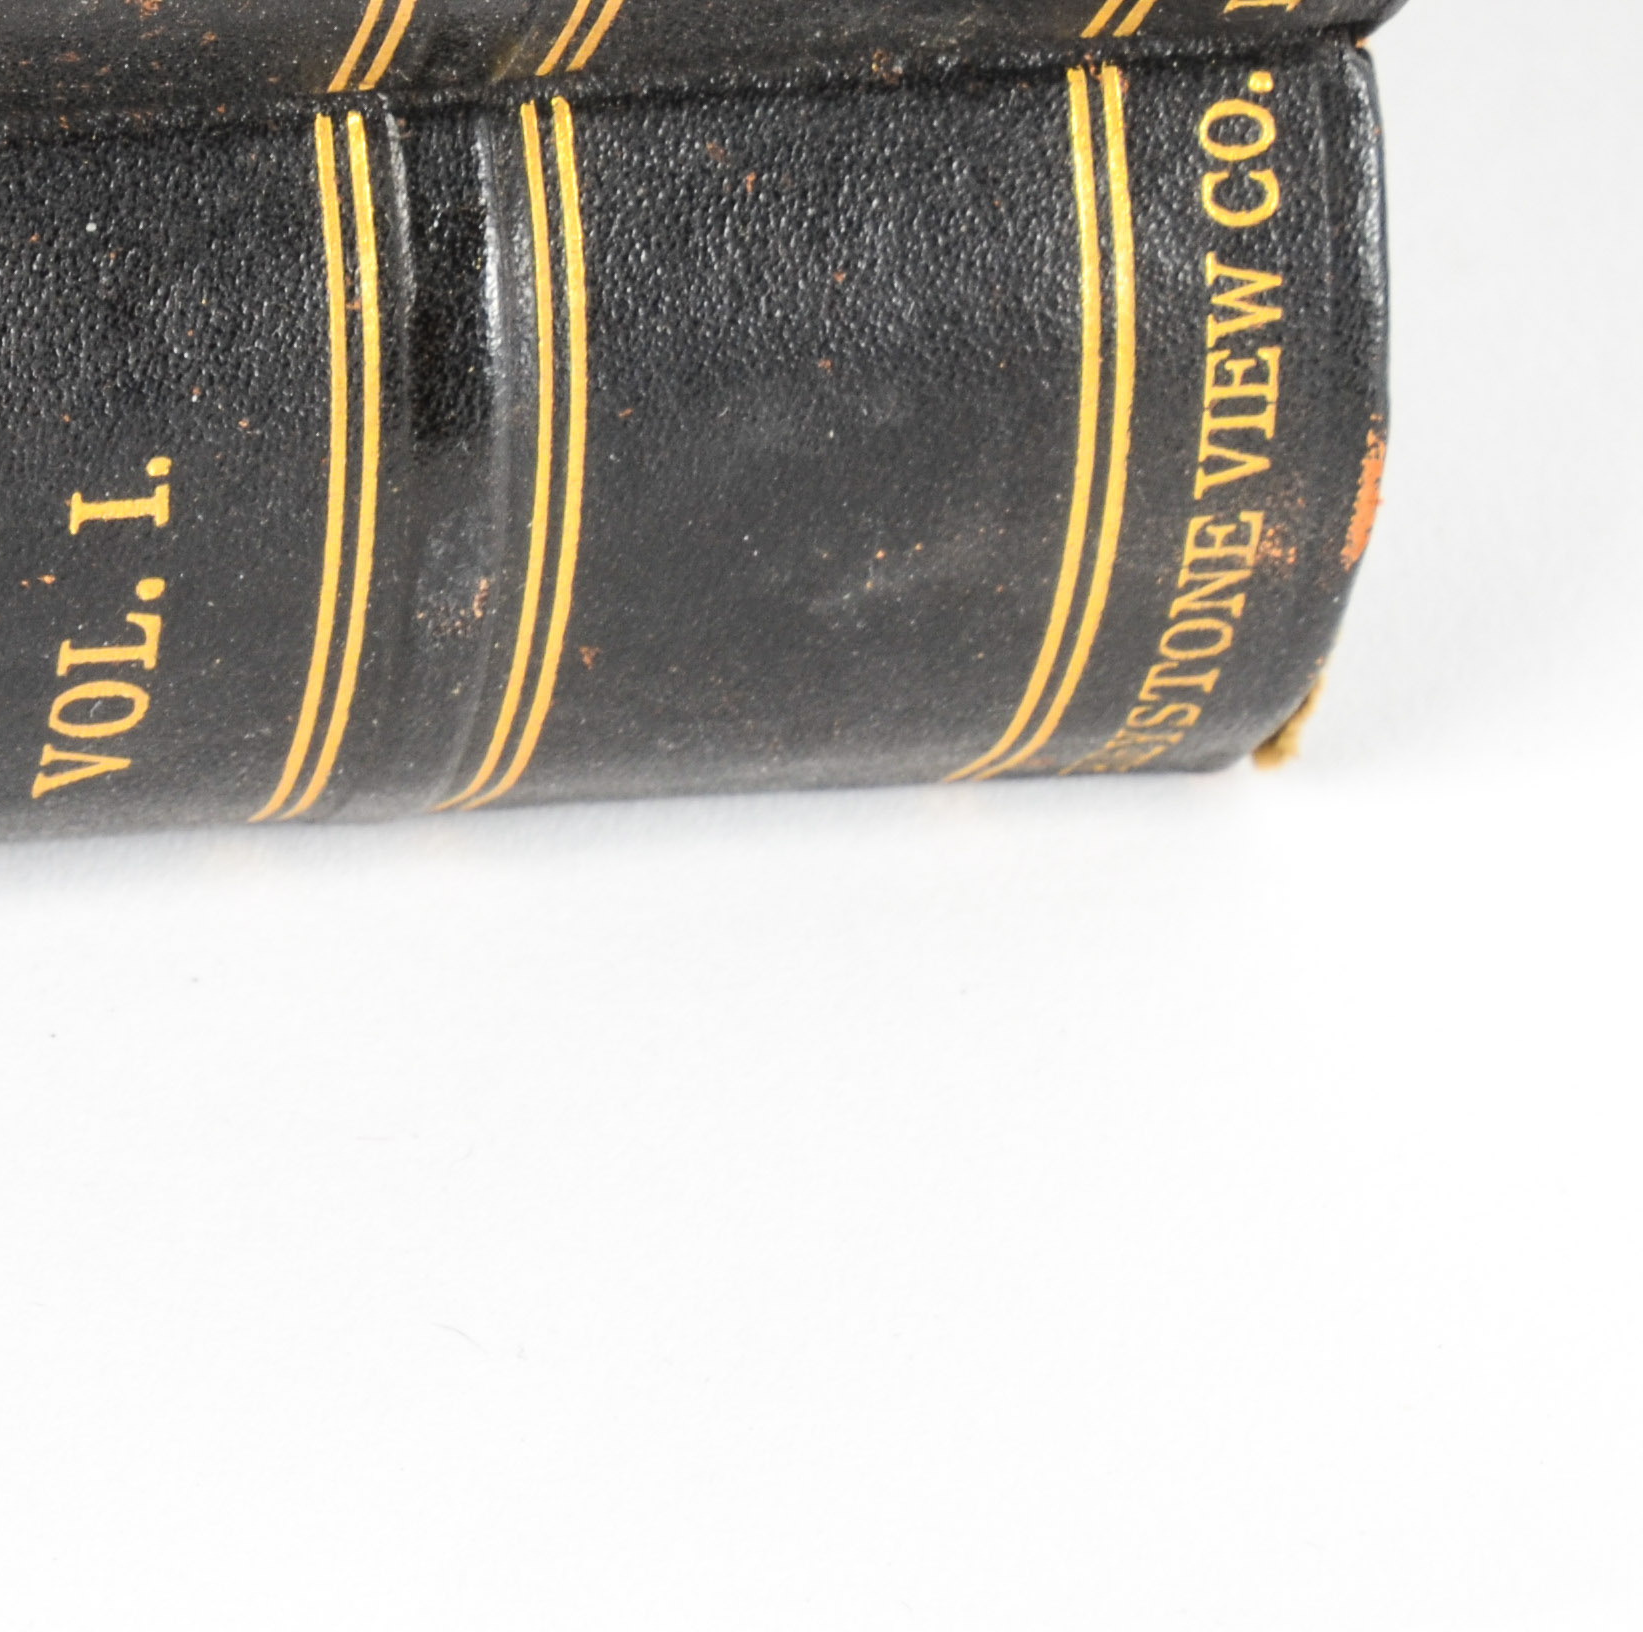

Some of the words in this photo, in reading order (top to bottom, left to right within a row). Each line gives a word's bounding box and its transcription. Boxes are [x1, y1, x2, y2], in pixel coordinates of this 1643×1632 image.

[1199, 70, 1281, 229] CO.
[1194, 251, 1283, 498] VIEW
[69, 456, 172, 535] I.
[31, 577, 166, 799] VOL.
